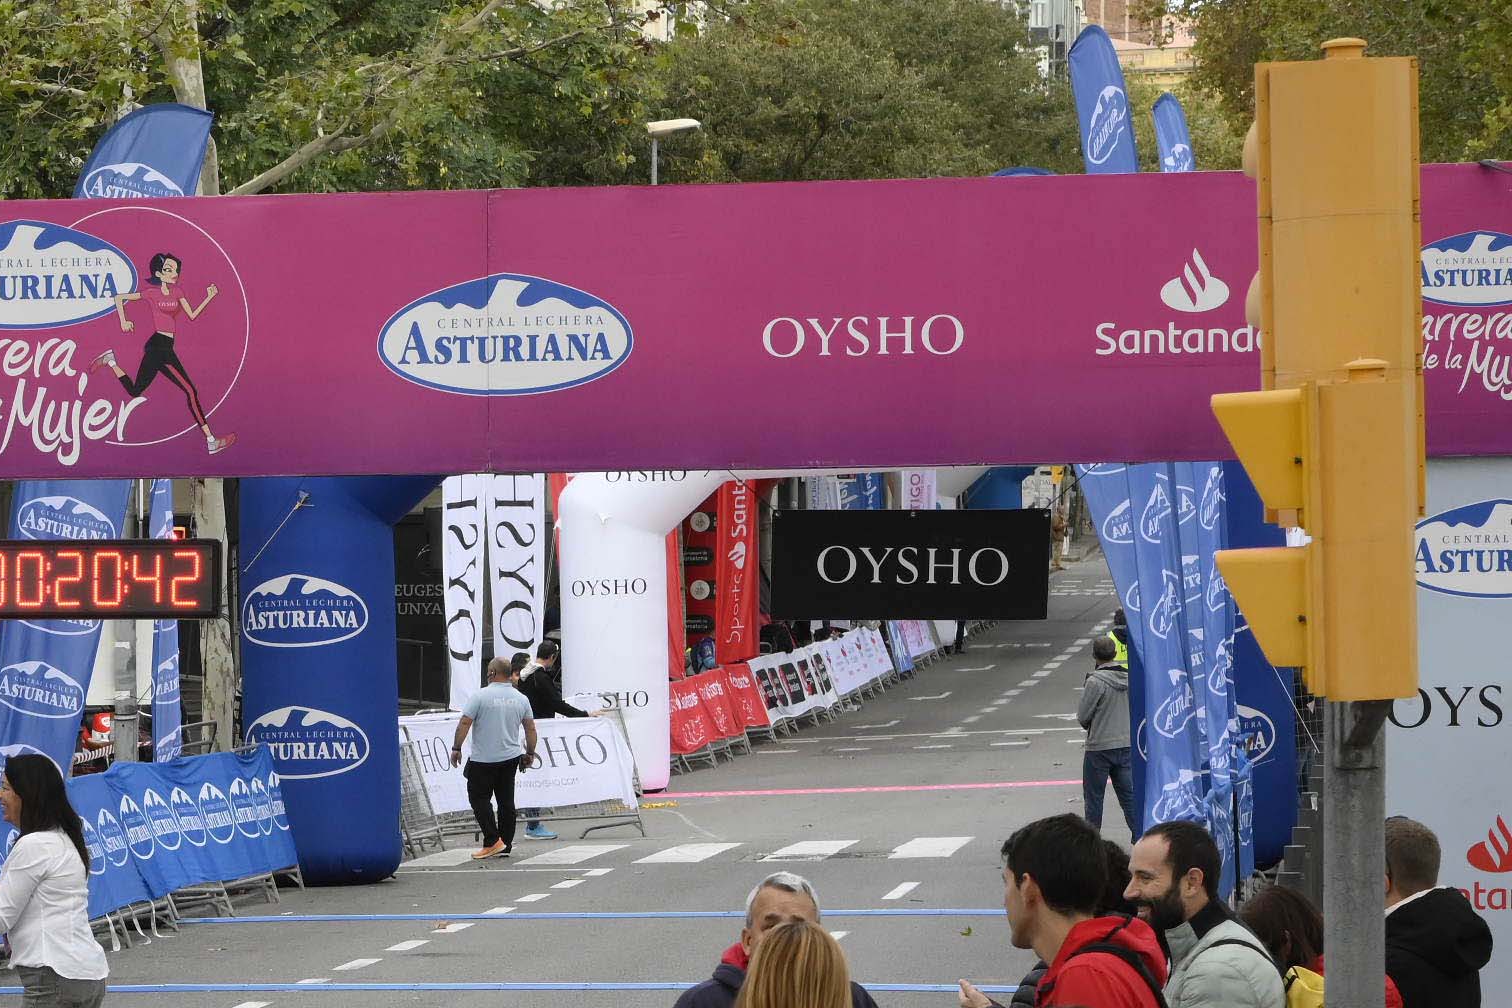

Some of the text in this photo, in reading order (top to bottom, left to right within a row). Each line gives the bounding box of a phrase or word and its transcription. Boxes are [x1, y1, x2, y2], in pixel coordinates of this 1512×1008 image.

[40, 256, 113, 267] LECHERA
[1435, 257, 1488, 266] CENTRAL
[436, 314, 605, 329] CENTRAL LECHERA
[1421, 312, 1512, 342] arrera
[397, 320, 613, 366] ASTURIANA
[762, 313, 965, 358] OYSHO
[1095, 321, 1263, 356] Santand
[1423, 342, 1440, 370] e
[1444, 341, 1463, 370] la
[22, 507, 109, 540] ASTURIANA
[40, 509, 109, 531] CENTRAL LECHERA
[1441, 533, 1510, 544] CENTRAL
[816, 544, 1010, 586] OYSHO
[1414, 536, 1512, 574] ASTUR
[571, 577, 648, 598] OYSHO
[305, 599, 355, 607] LECHERA
[246, 606, 359, 631] ASTURIANA
[14, 675, 79, 694] CENTRAL LECHERA
[1388, 684, 1503, 729] OYS
[260, 730, 355, 739] CENTRAL LECHERA
[250, 735, 360, 761] TURIANA
